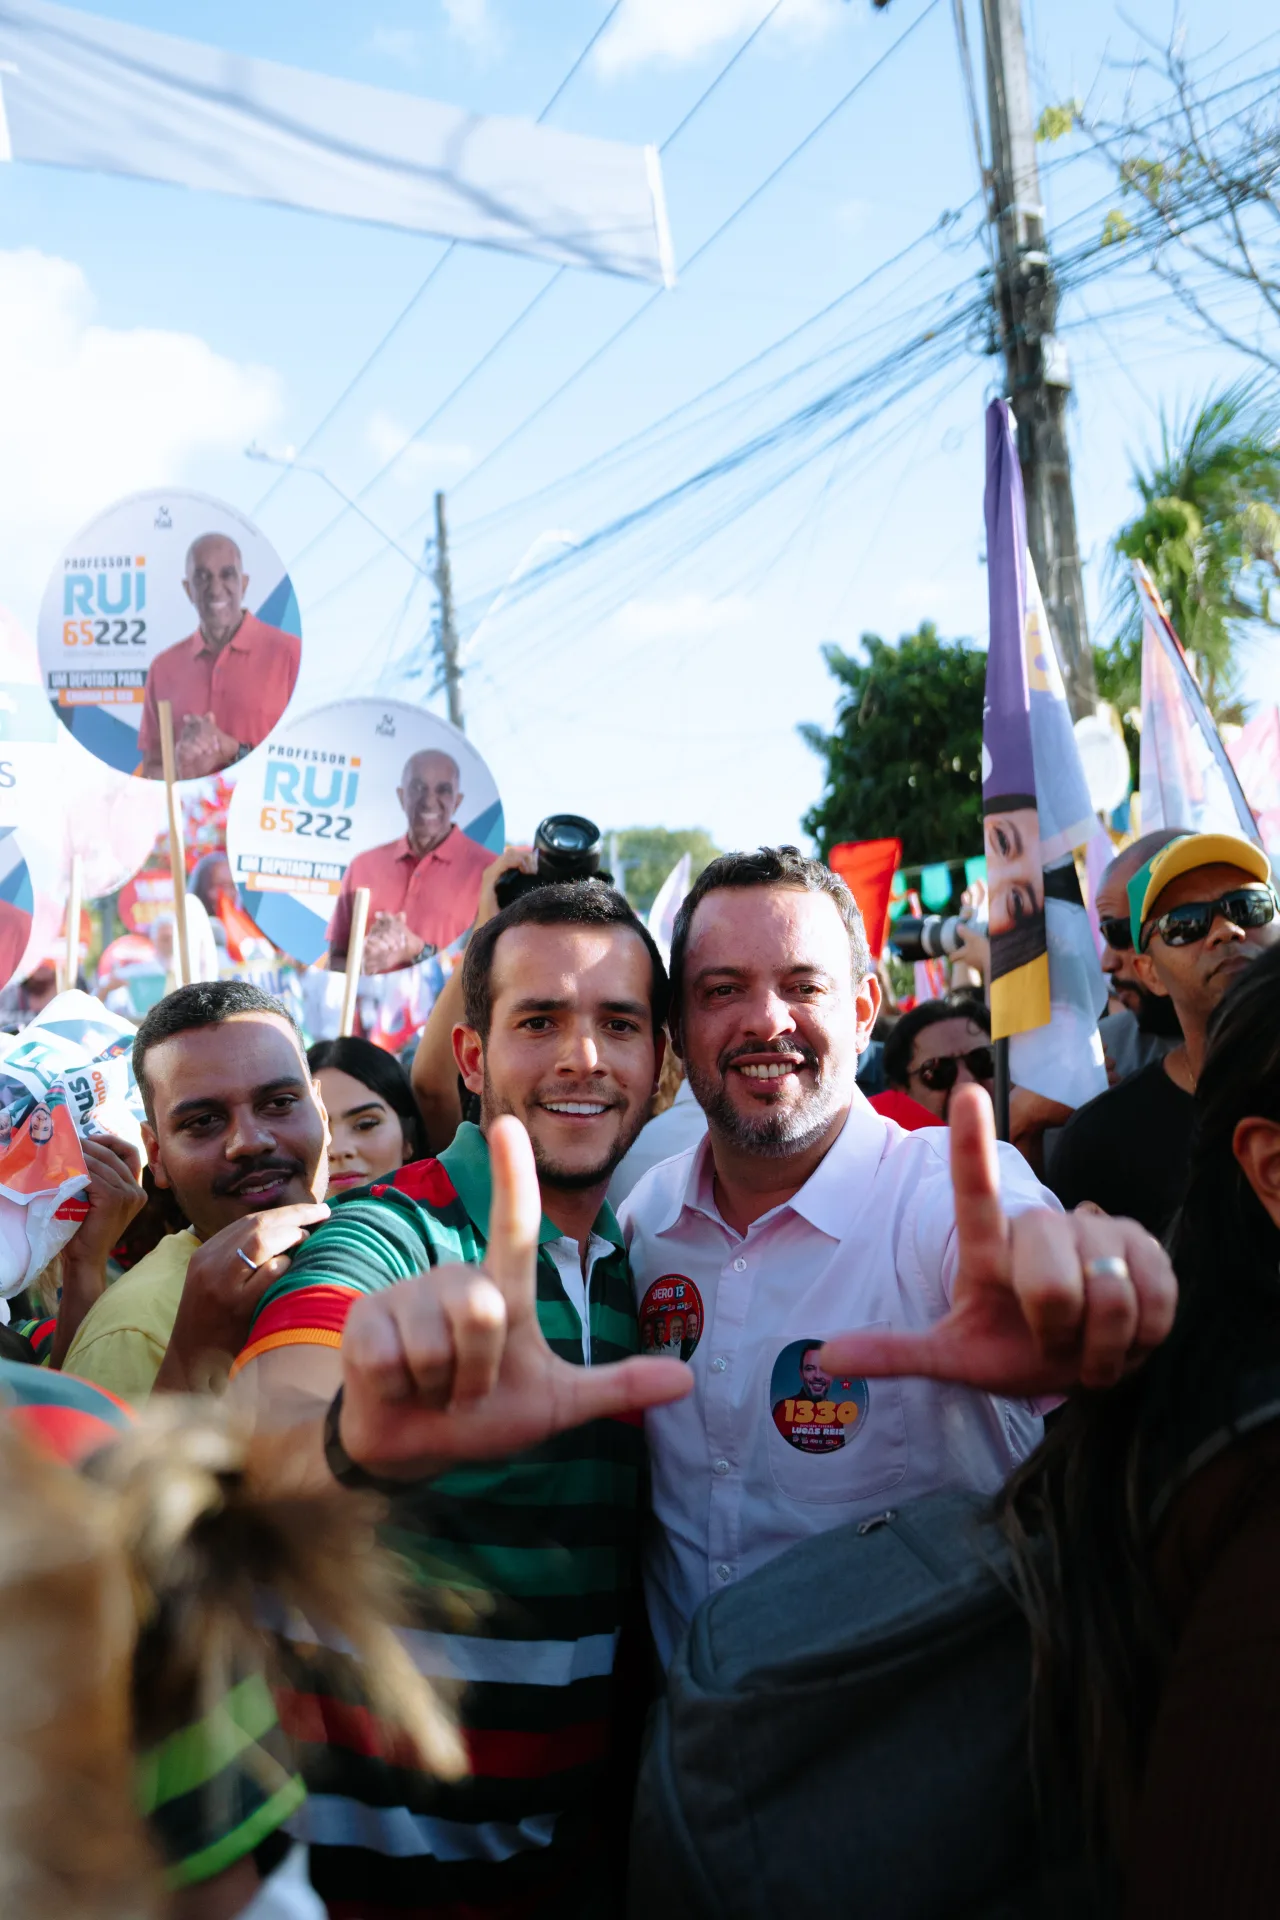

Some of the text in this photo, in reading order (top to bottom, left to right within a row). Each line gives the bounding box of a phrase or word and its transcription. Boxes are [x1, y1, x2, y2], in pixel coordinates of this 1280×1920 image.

[64, 556, 131, 569] PROFESSOR
[63, 619, 147, 646] 65222
[70, 672, 115, 688] DEPUTADO
[117, 671, 143, 688] PARA
[268, 744, 346, 765] PROFESSOR
[260, 807, 353, 841] 65222
[652, 1285, 685, 1300] JERO 13
[784, 1399, 859, 1424] 1330
[791, 1427, 821, 1435] LUCAS
